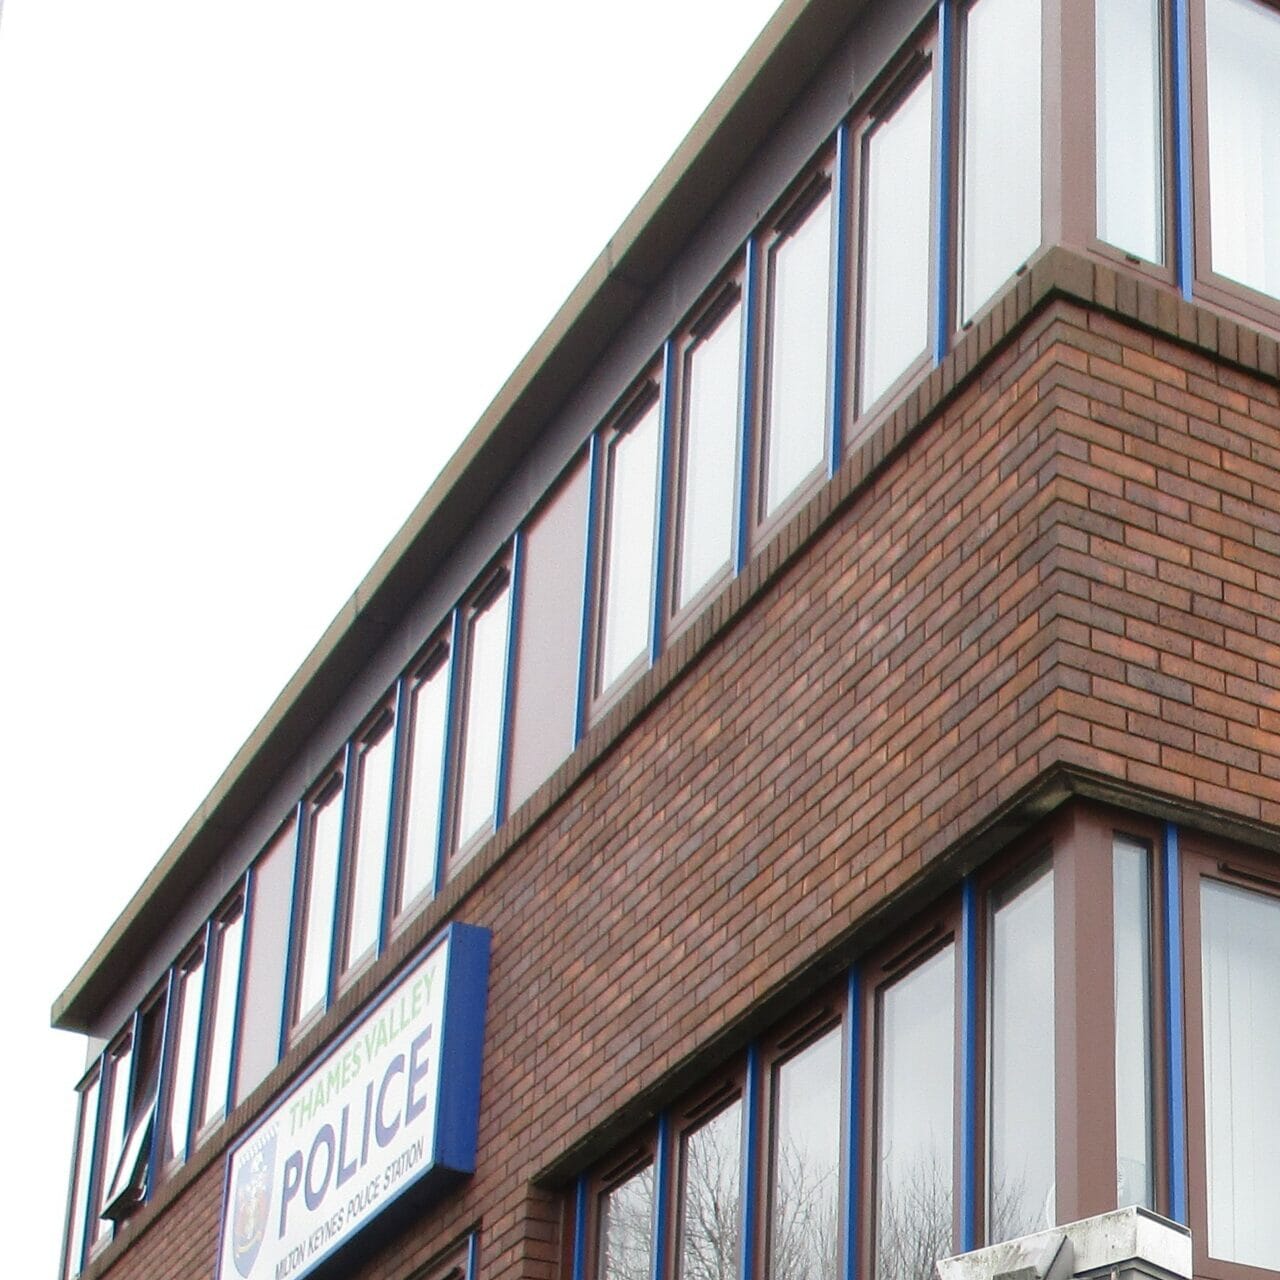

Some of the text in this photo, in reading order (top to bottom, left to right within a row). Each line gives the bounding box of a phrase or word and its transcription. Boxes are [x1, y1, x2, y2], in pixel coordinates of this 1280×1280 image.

[278, 1022, 433, 1241] POLICE
[289, 965, 437, 1136] THAMES VALLEY
[307, 1206, 345, 1257] KEYNES
[346, 1173, 382, 1223] POLICE
[383, 1135, 424, 1191] STATION
